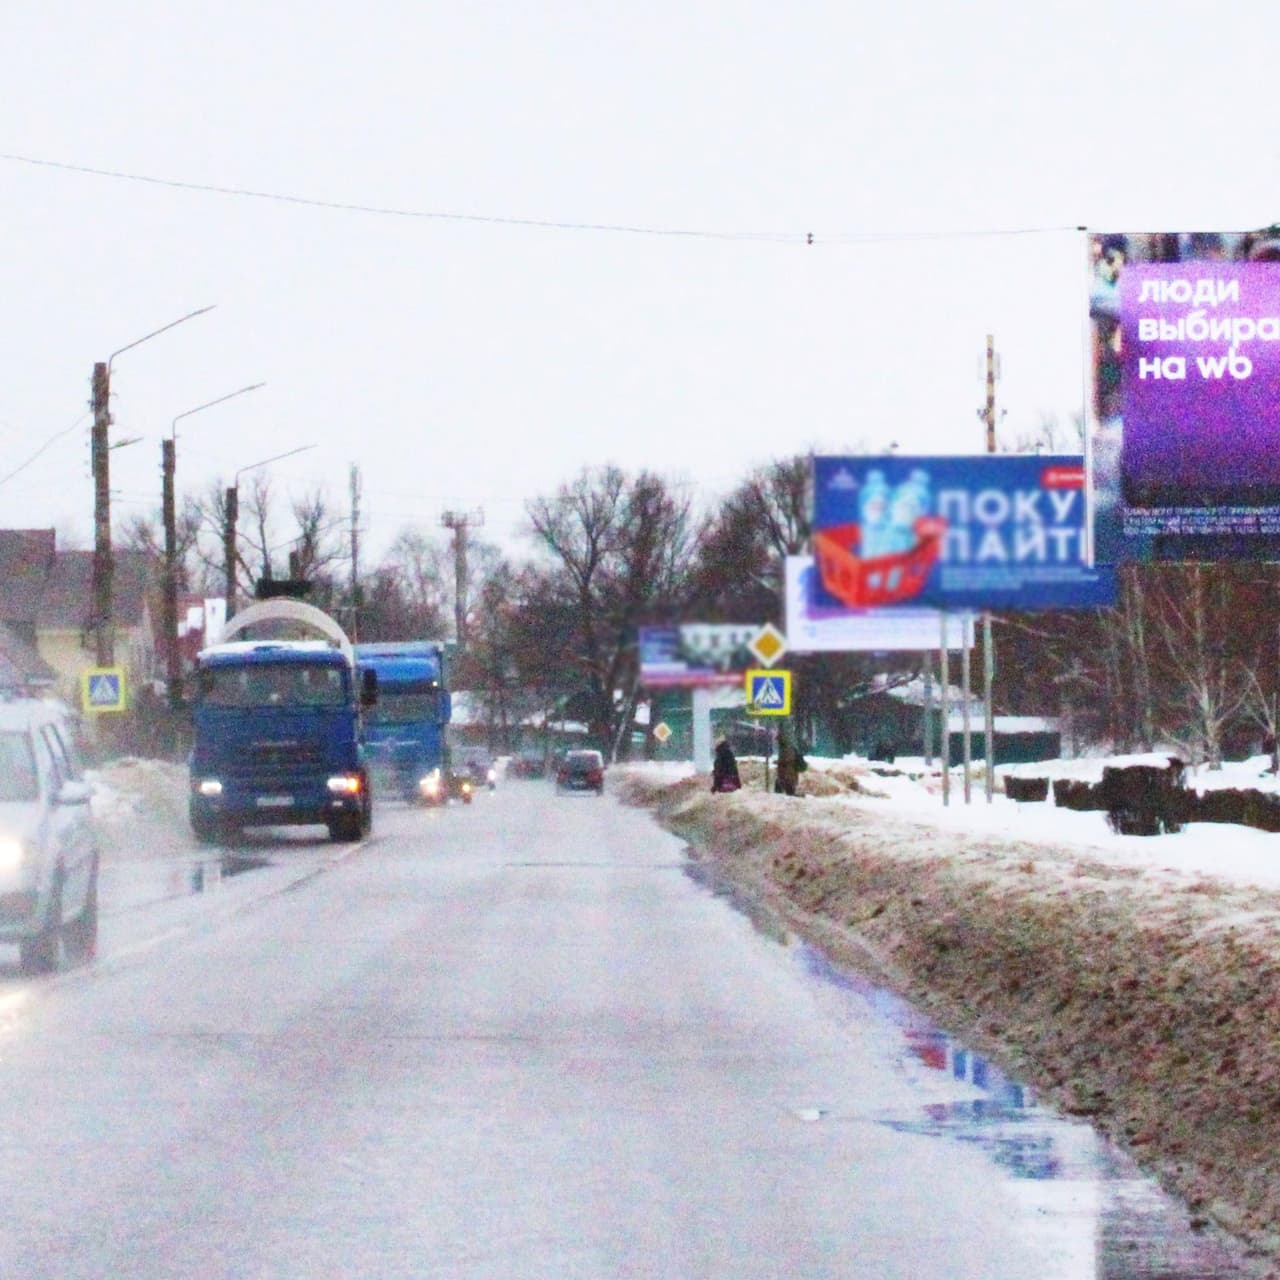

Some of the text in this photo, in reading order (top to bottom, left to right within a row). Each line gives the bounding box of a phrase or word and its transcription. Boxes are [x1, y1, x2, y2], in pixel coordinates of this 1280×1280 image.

[1138, 279, 1240, 307] люди
[1138, 347, 1253, 380] на wb
[938, 489, 1076, 526] ПОКУ
